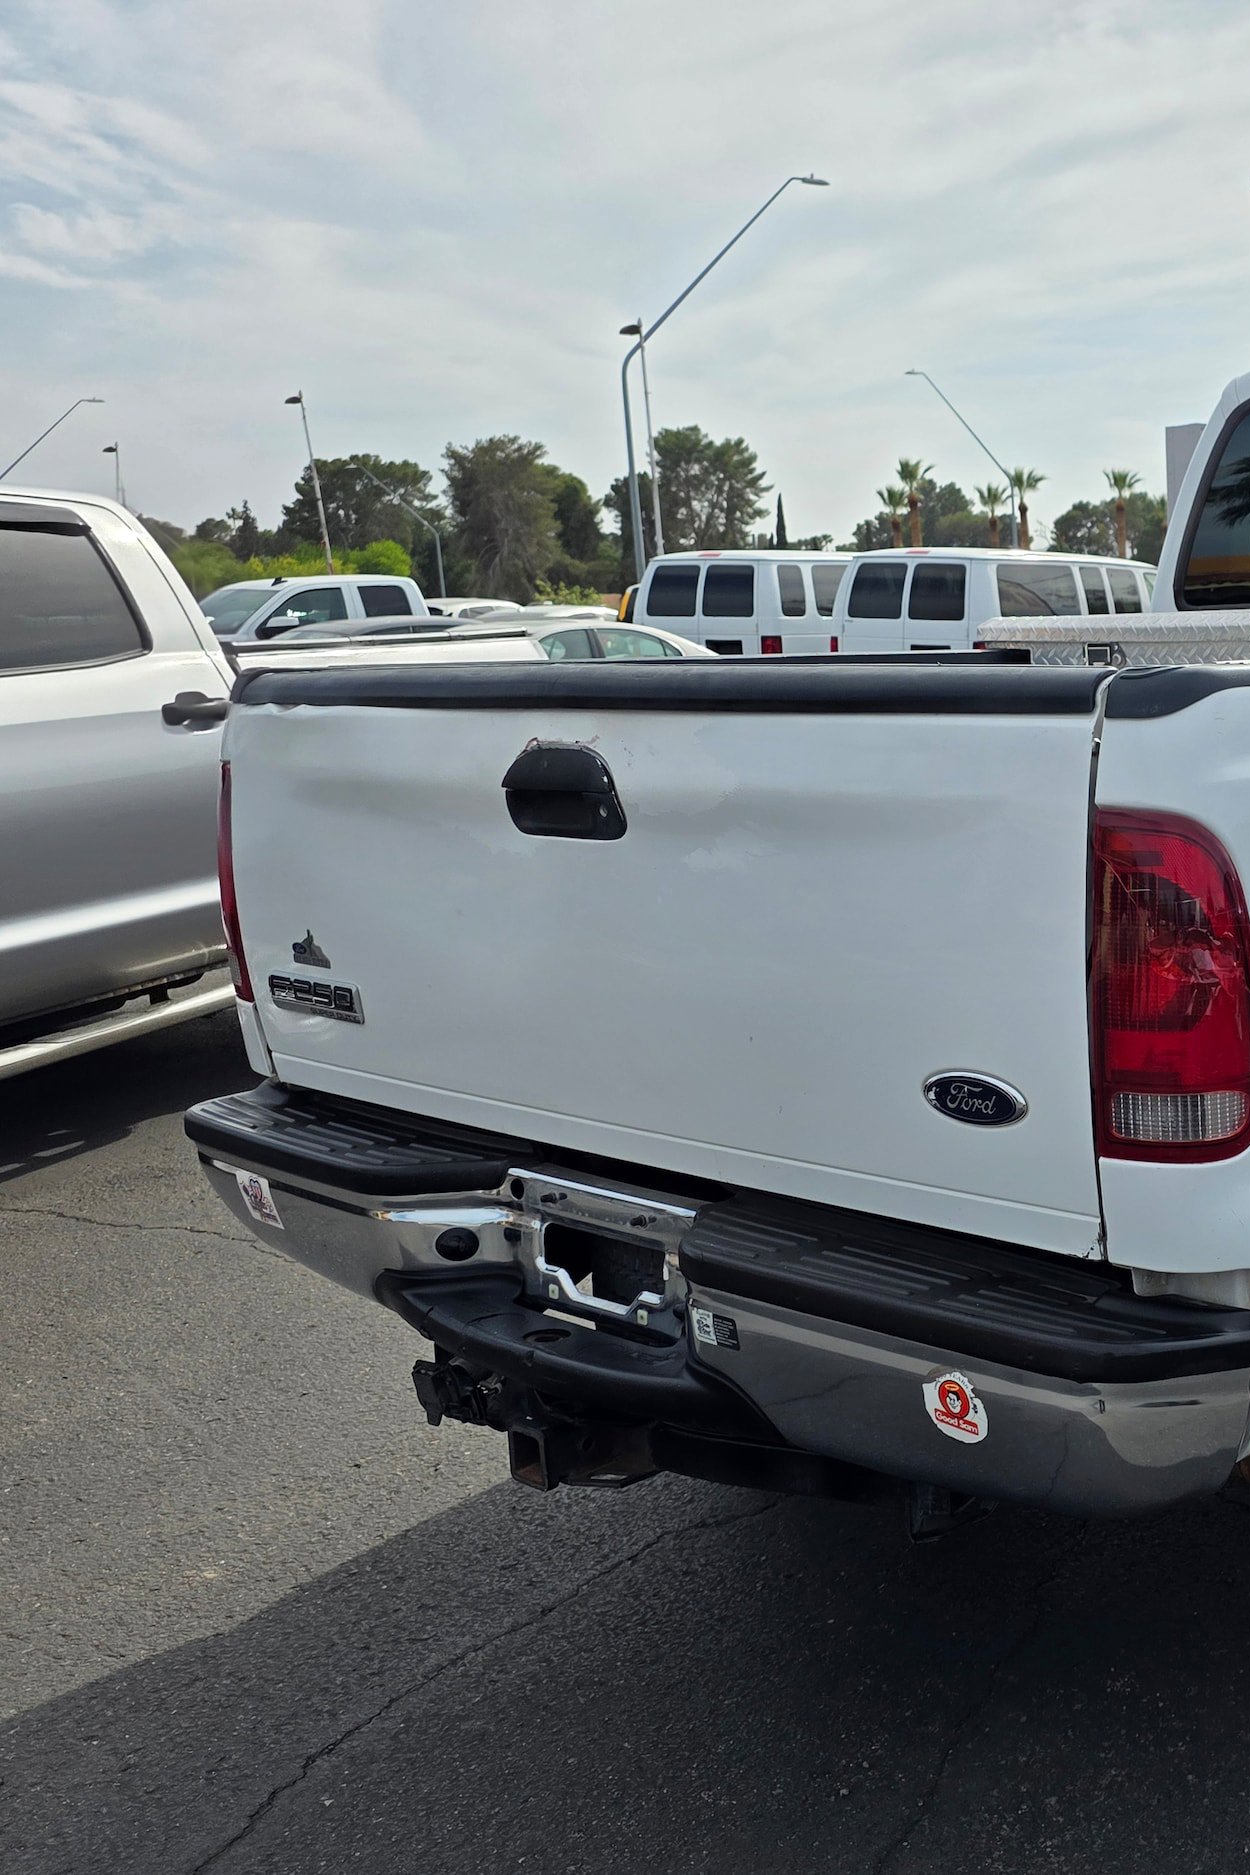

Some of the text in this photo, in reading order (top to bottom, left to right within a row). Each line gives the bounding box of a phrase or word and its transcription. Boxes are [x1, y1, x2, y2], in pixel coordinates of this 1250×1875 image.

[946, 1082, 997, 1115] Ford
[936, 1411, 978, 1434] Good Sam
